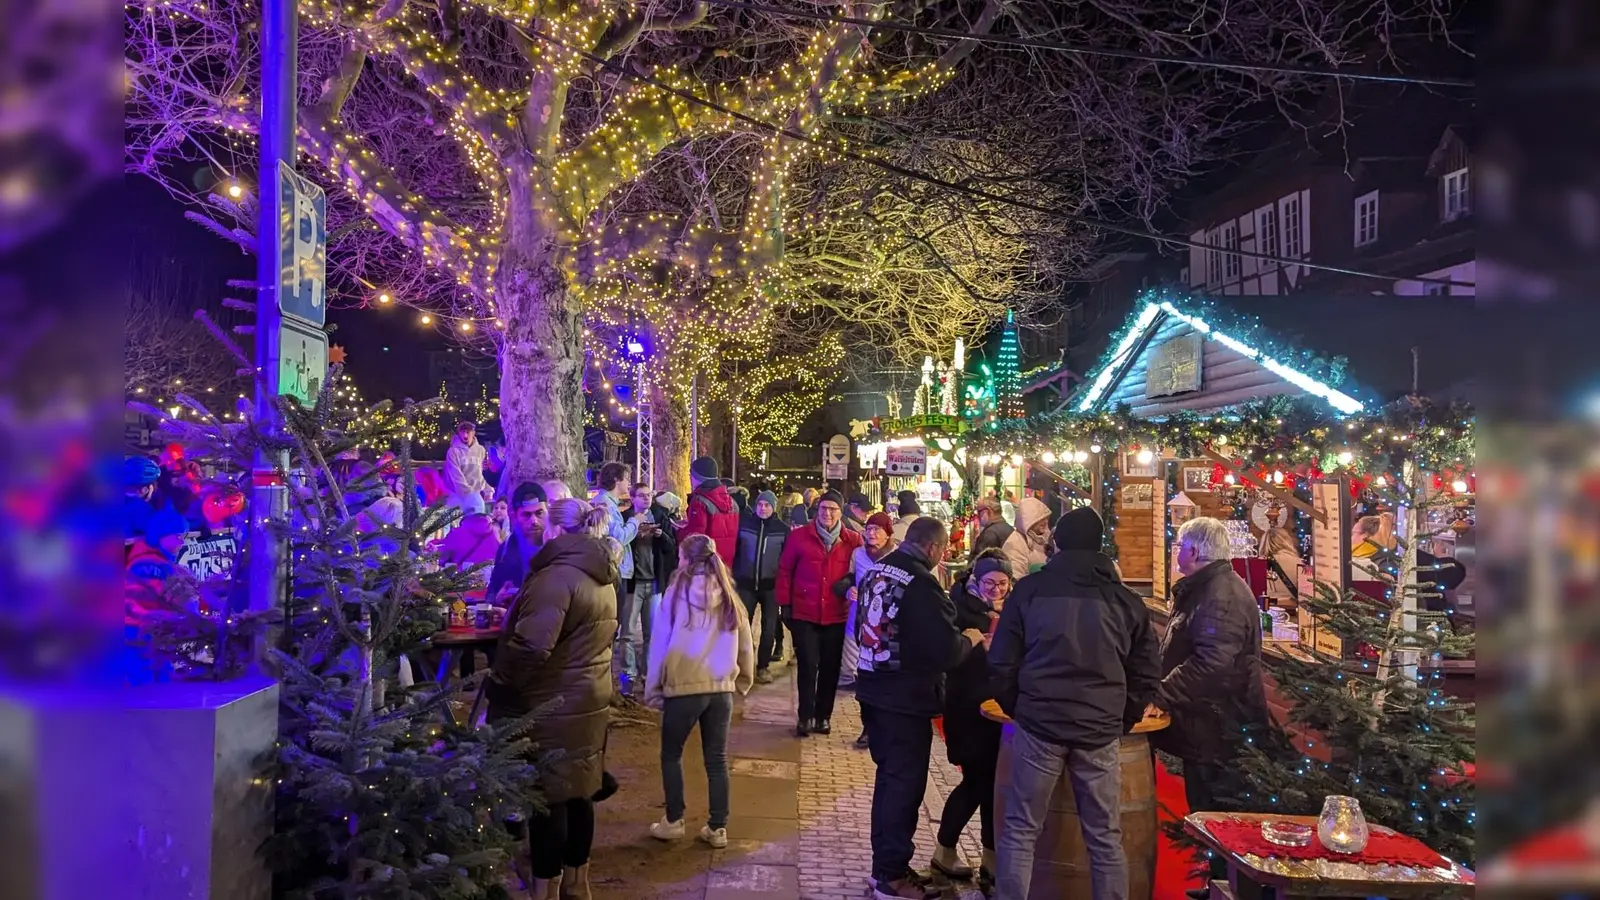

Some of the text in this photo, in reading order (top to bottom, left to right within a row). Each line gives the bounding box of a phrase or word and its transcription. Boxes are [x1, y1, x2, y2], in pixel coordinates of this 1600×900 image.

[293, 188, 317, 299] P
[882, 415, 952, 430] FROHES FEST
